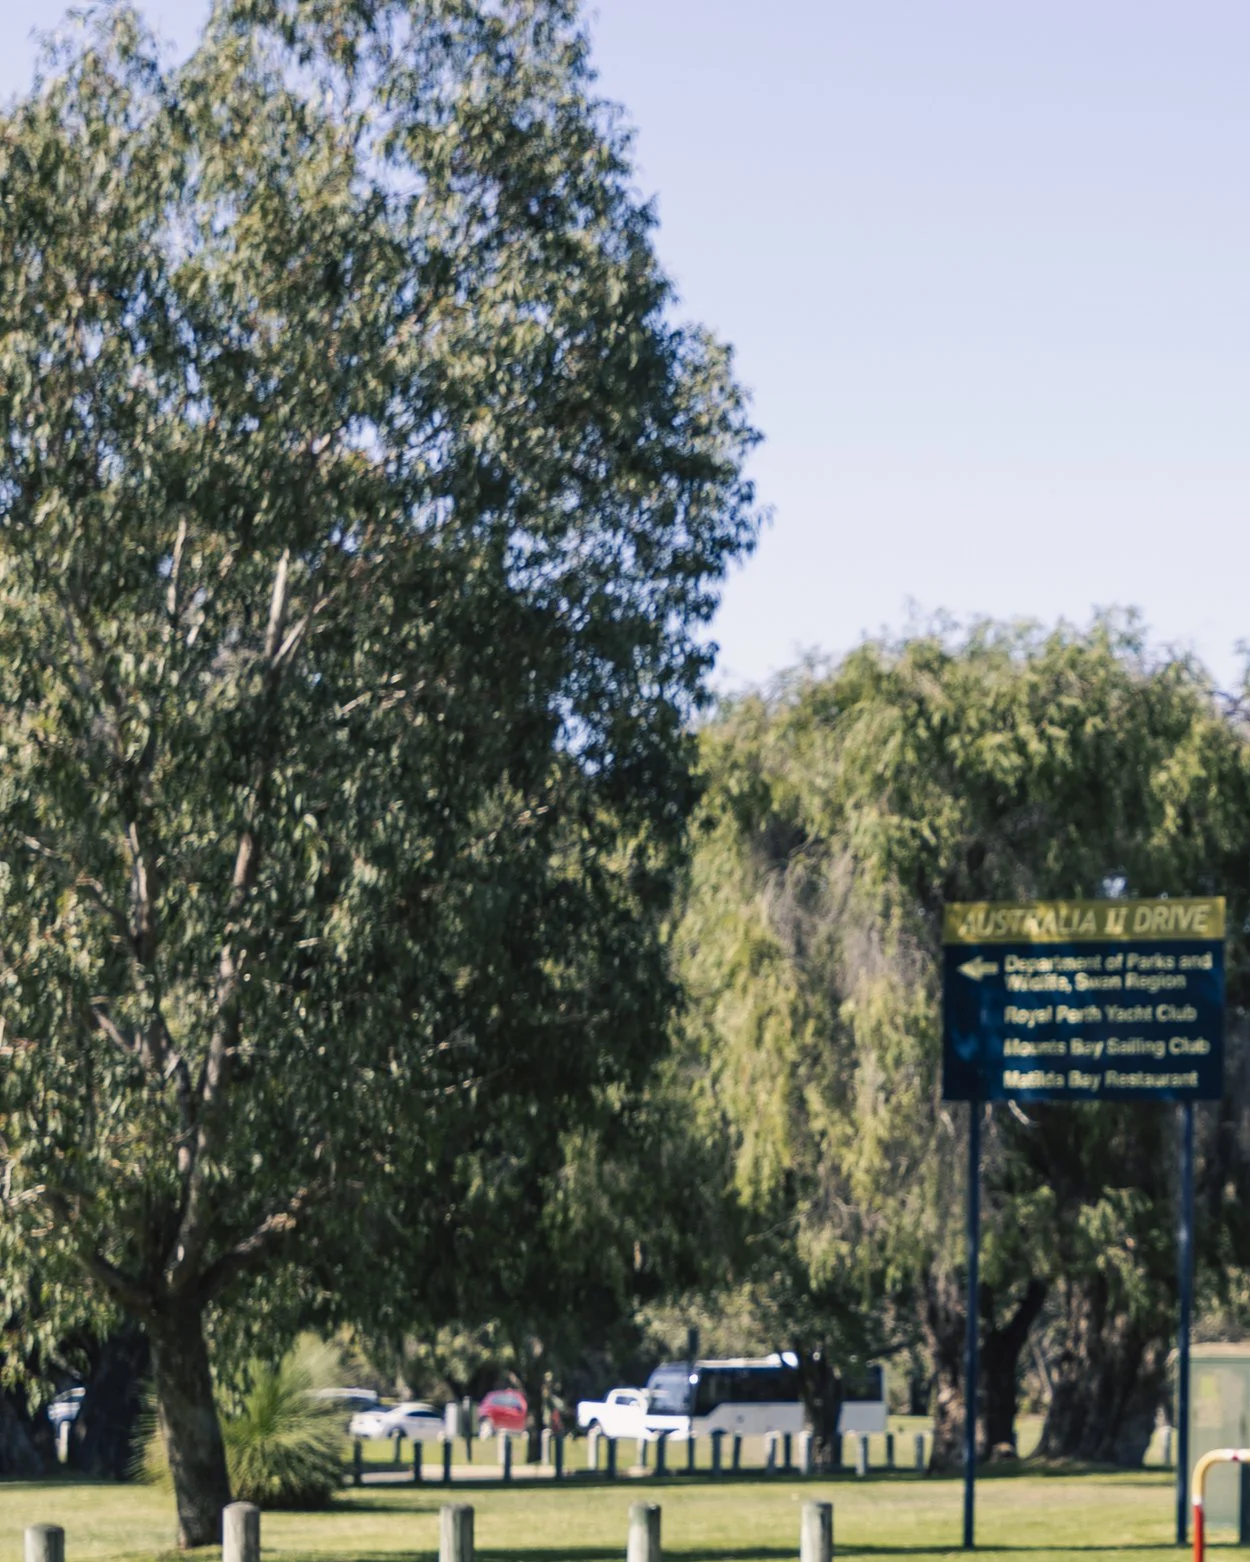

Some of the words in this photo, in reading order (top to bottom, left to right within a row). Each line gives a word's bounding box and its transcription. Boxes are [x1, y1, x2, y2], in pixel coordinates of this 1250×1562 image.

[958, 906, 1097, 938] AUSTRALIA
[1133, 903, 1211, 934] DRIVE
[1004, 954, 1101, 975] Department
[1105, 953, 1123, 971] of
[1127, 952, 1175, 970] Parks
[1179, 951, 1213, 970] and
[1075, 972, 1121, 991] Swan
[1125, 972, 1187, 993] Region
[1004, 1006, 1052, 1028] Royal
[1055, 1005, 1102, 1023] Perth
[1105, 1004, 1153, 1022] Yacht
[1155, 1003, 1198, 1022] Club
[1003, 1039, 1066, 1056] Mounts
[1069, 1038, 1104, 1059] Bay
[1106, 1037, 1166, 1058] Sailing
[1169, 1036, 1211, 1055] Club
[1003, 1070, 1065, 1088] Matilda
[1068, 1070, 1102, 1092] Bay
[1104, 1069, 1199, 1088] Restaurant
